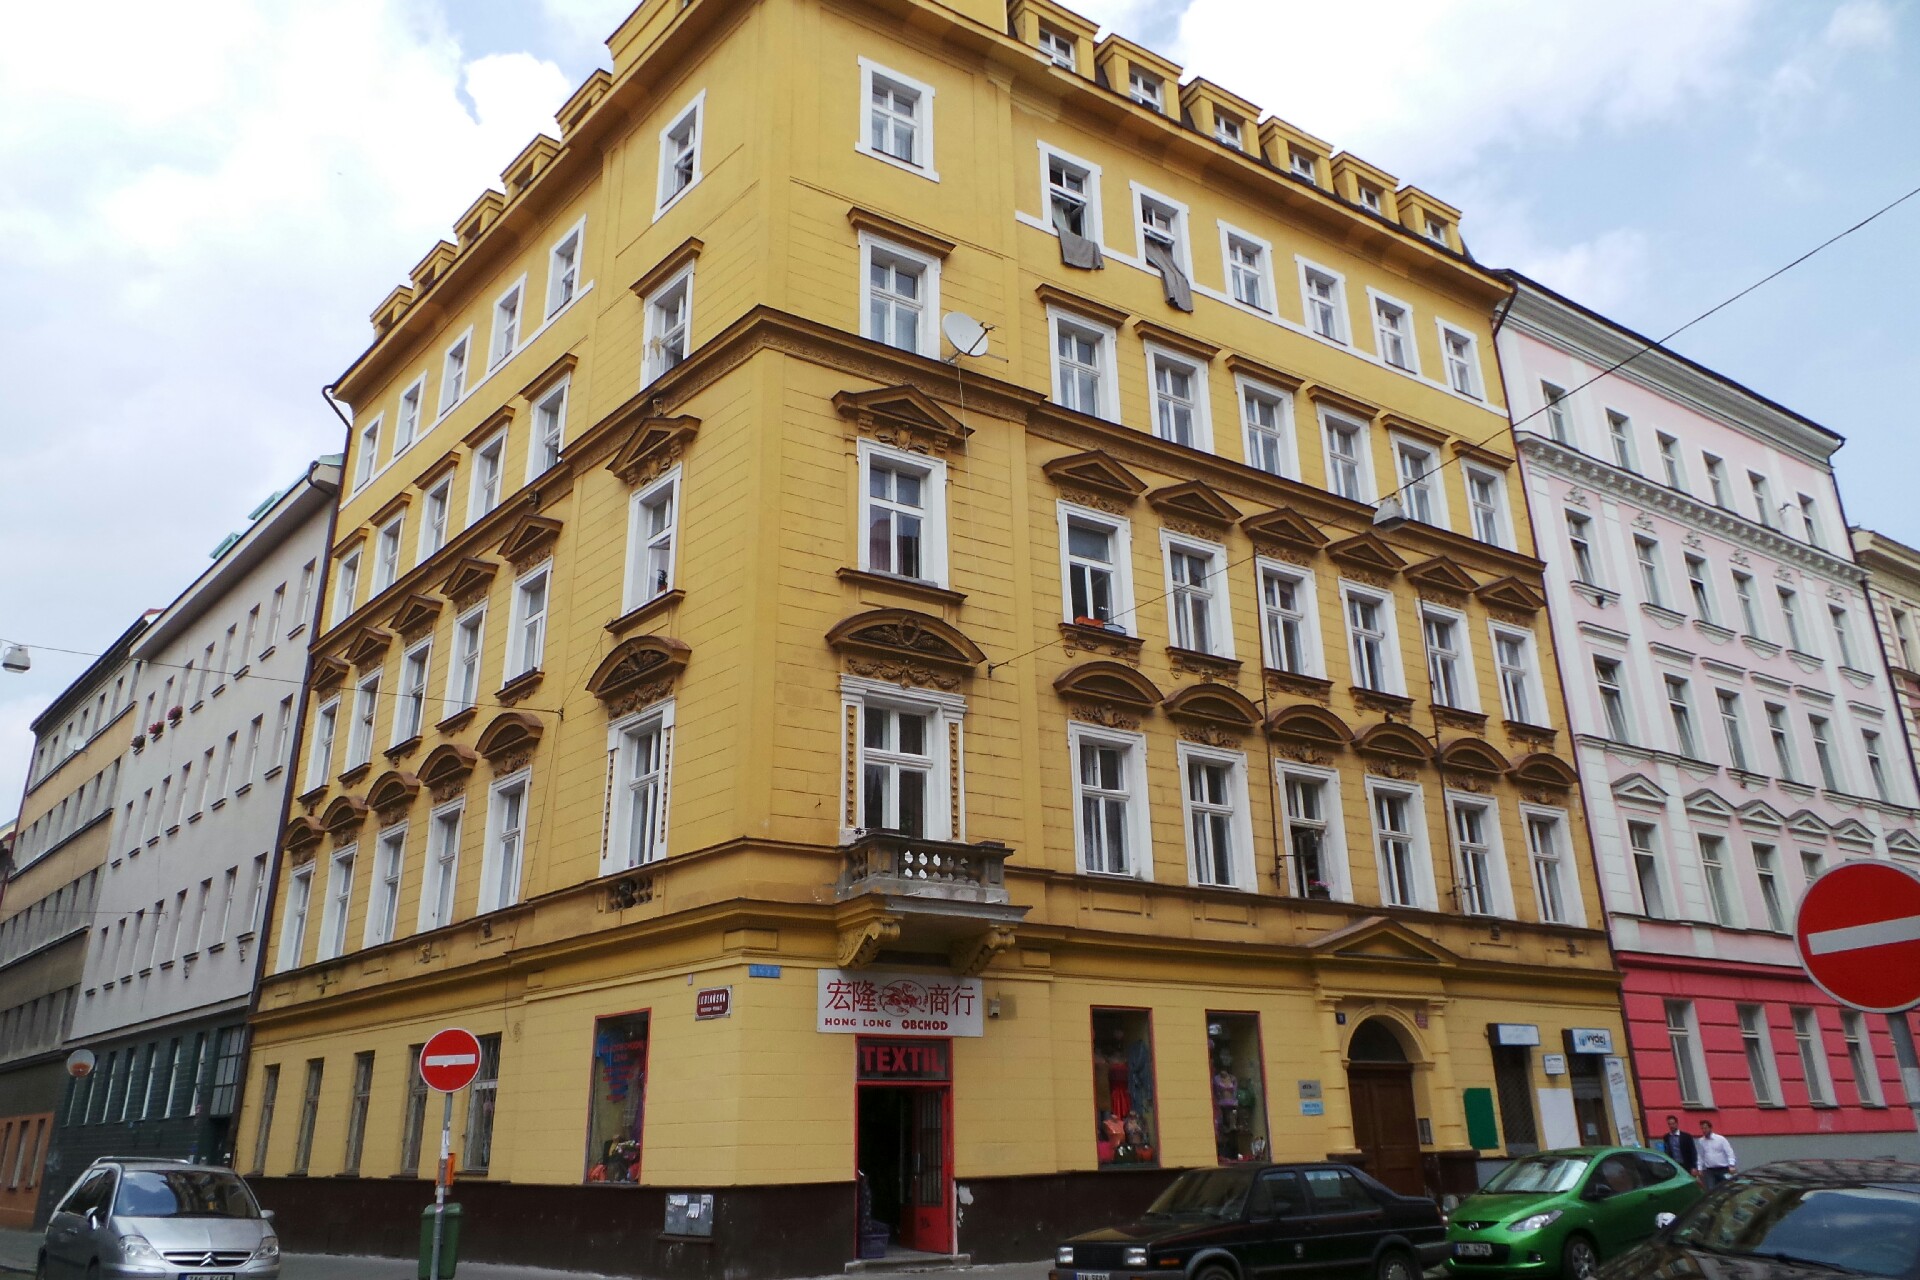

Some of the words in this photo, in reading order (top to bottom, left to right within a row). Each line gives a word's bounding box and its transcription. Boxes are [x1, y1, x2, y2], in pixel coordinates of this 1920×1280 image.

[825, 979, 879, 1012] 宏隆
[928, 983, 975, 1016] 商行
[825, 1018, 857, 1026] HONG
[863, 1019, 892, 1027] LONG
[901, 1019, 949, 1031] OBCHOD
[861, 1046, 944, 1073] TEXTIL
